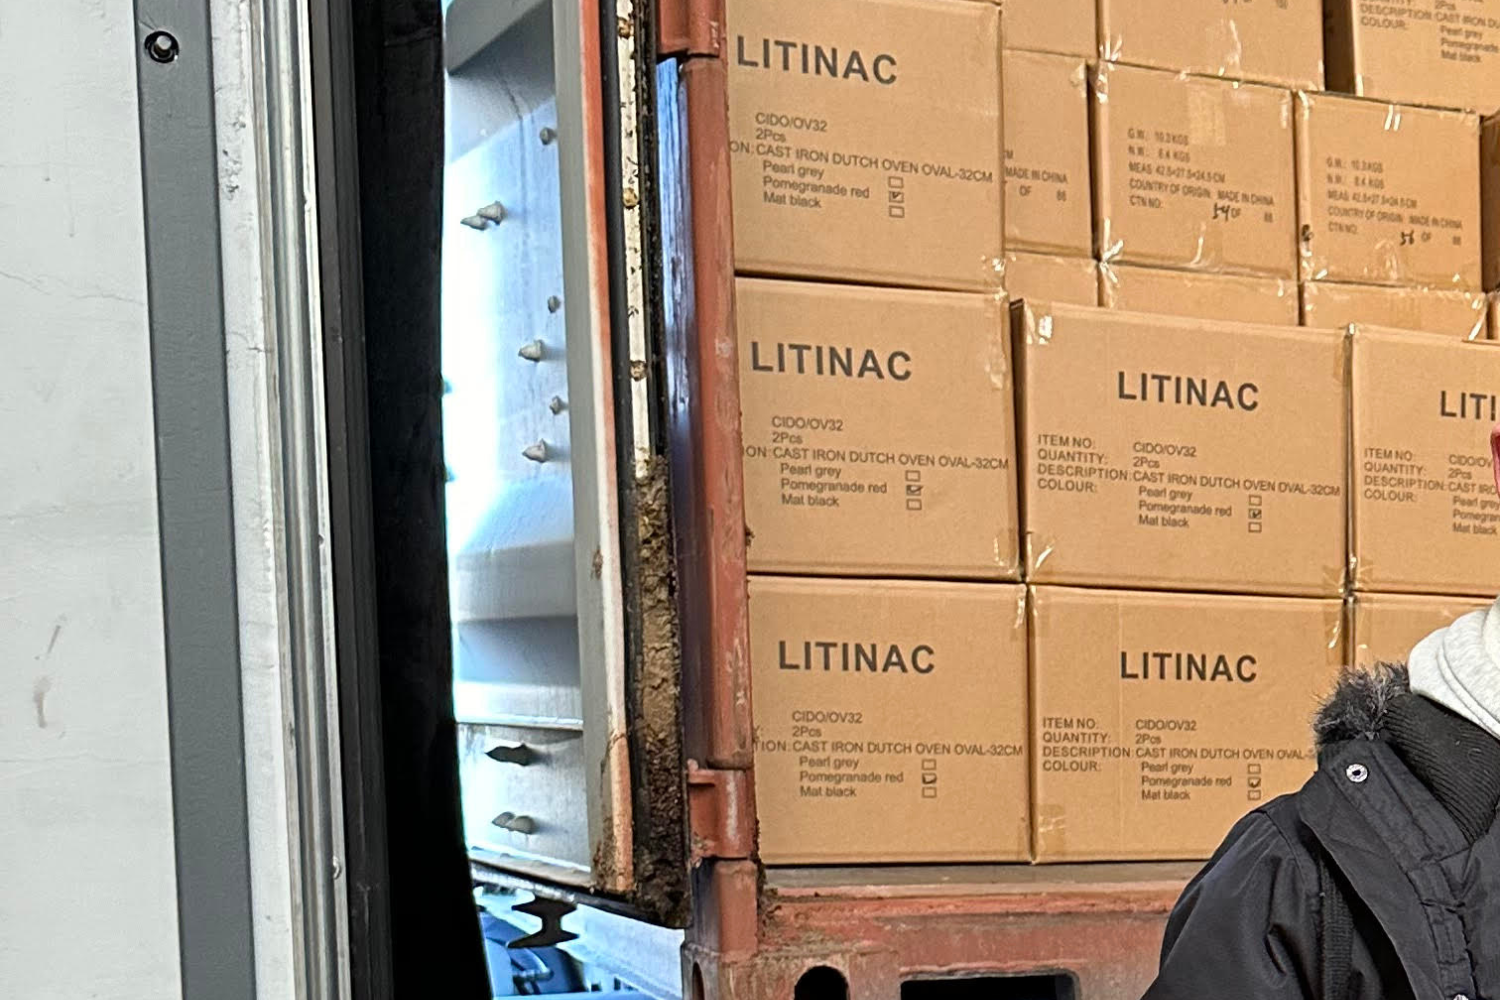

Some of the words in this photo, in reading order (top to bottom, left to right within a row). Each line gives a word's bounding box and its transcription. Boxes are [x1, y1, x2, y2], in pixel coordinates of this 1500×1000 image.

[737, 35, 898, 85] LITINAC
[755, 112, 828, 132] CIDO/OV32
[755, 127, 786, 143] 2Pcs
[756, 143, 791, 158] CAST
[795, 149, 829, 163] IRON
[831, 152, 878, 169] DUTCH
[882, 158, 919, 174] OVEN
[921, 163, 993, 182] OVAL-32CM
[763, 160, 795, 174] Pearl
[797, 166, 825, 180] grey
[763, 175, 847, 195] Pomegranade
[851, 186, 870, 199] red
[763, 191, 786, 205] Mat
[789, 194, 822, 209] black
[751, 340, 912, 382] LITINAC
[1117, 371, 1260, 413] LITINAC
[771, 416, 844, 432] CIDO/OV32
[772, 431, 803, 444] 2Pcs
[1037, 433, 1069, 447] ITEM
[773, 446, 809, 460] CAST
[812, 449, 846, 462] IRON
[849, 450, 895, 464] DUTCH
[898, 453, 935, 467] OVEN
[938, 455, 1009, 470] OVAL-32CM
[1037, 448, 1108, 465] QUANTITY:
[1132, 456, 1160, 469] 2Pcs
[1364, 447, 1394, 460] ITEM
[780, 462, 812, 475] Pearl
[815, 467, 841, 479] grey
[1448, 468, 1472, 480] 2Pcs
[780, 478, 865, 493] Pomegranade
[868, 482, 888, 494] red
[1133, 470, 1164, 484] CAST
[1167, 473, 1198, 487] IRON
[1200, 475, 1240, 489] DUTCH
[1243, 479, 1276, 492] OVEN
[1448, 482, 1476, 494] CAST
[1478, 484, 1497, 495] IRO
[781, 493, 805, 506] Mat
[807, 494, 840, 507] black
[1139, 486, 1167, 498] Pearl
[1169, 490, 1193, 503] grey
[1453, 495, 1477, 508] Pearl
[1139, 500, 1212, 515] Pomegranade
[1215, 505, 1232, 517] red
[1139, 514, 1159, 527] Mat
[1161, 515, 1189, 528] black
[1453, 522, 1471, 534] Mat
[1473, 523, 1497, 535] black
[778, 640, 935, 674] LITINAC
[1120, 651, 1258, 683] LITINAC
[792, 710, 863, 724] CIDO/OV32
[1043, 717, 1074, 729] ITEM
[792, 725, 822, 738] 2Pcs
[1135, 733, 1161, 745] 2Pcs
[793, 740, 827, 753] CAST
[831, 741, 863, 753] IRON
[867, 742, 912, 755] DUTCH
[915, 743, 951, 755] OVEN
[954, 743, 1023, 756] OVAL-32CM
[1136, 747, 1166, 759] CAST
[1169, 748, 1198, 759] IRON
[1200, 748, 1240, 759] DUTCH
[1242, 748, 1274, 760] OVEN
[799, 756, 831, 768] Pearl
[834, 758, 859, 771] grey
[1141, 761, 1168, 773] Pearl
[1171, 763, 1194, 775] grey
[799, 771, 881, 784] Pomegranade
[885, 771, 904, 783] red
[1141, 776, 1213, 788] Pomegranade
[1215, 777, 1232, 787] red
[800, 786, 822, 797] Mat
[825, 786, 857, 798] black
[1141, 789, 1161, 800] Mat
[1164, 789, 1190, 800] black
